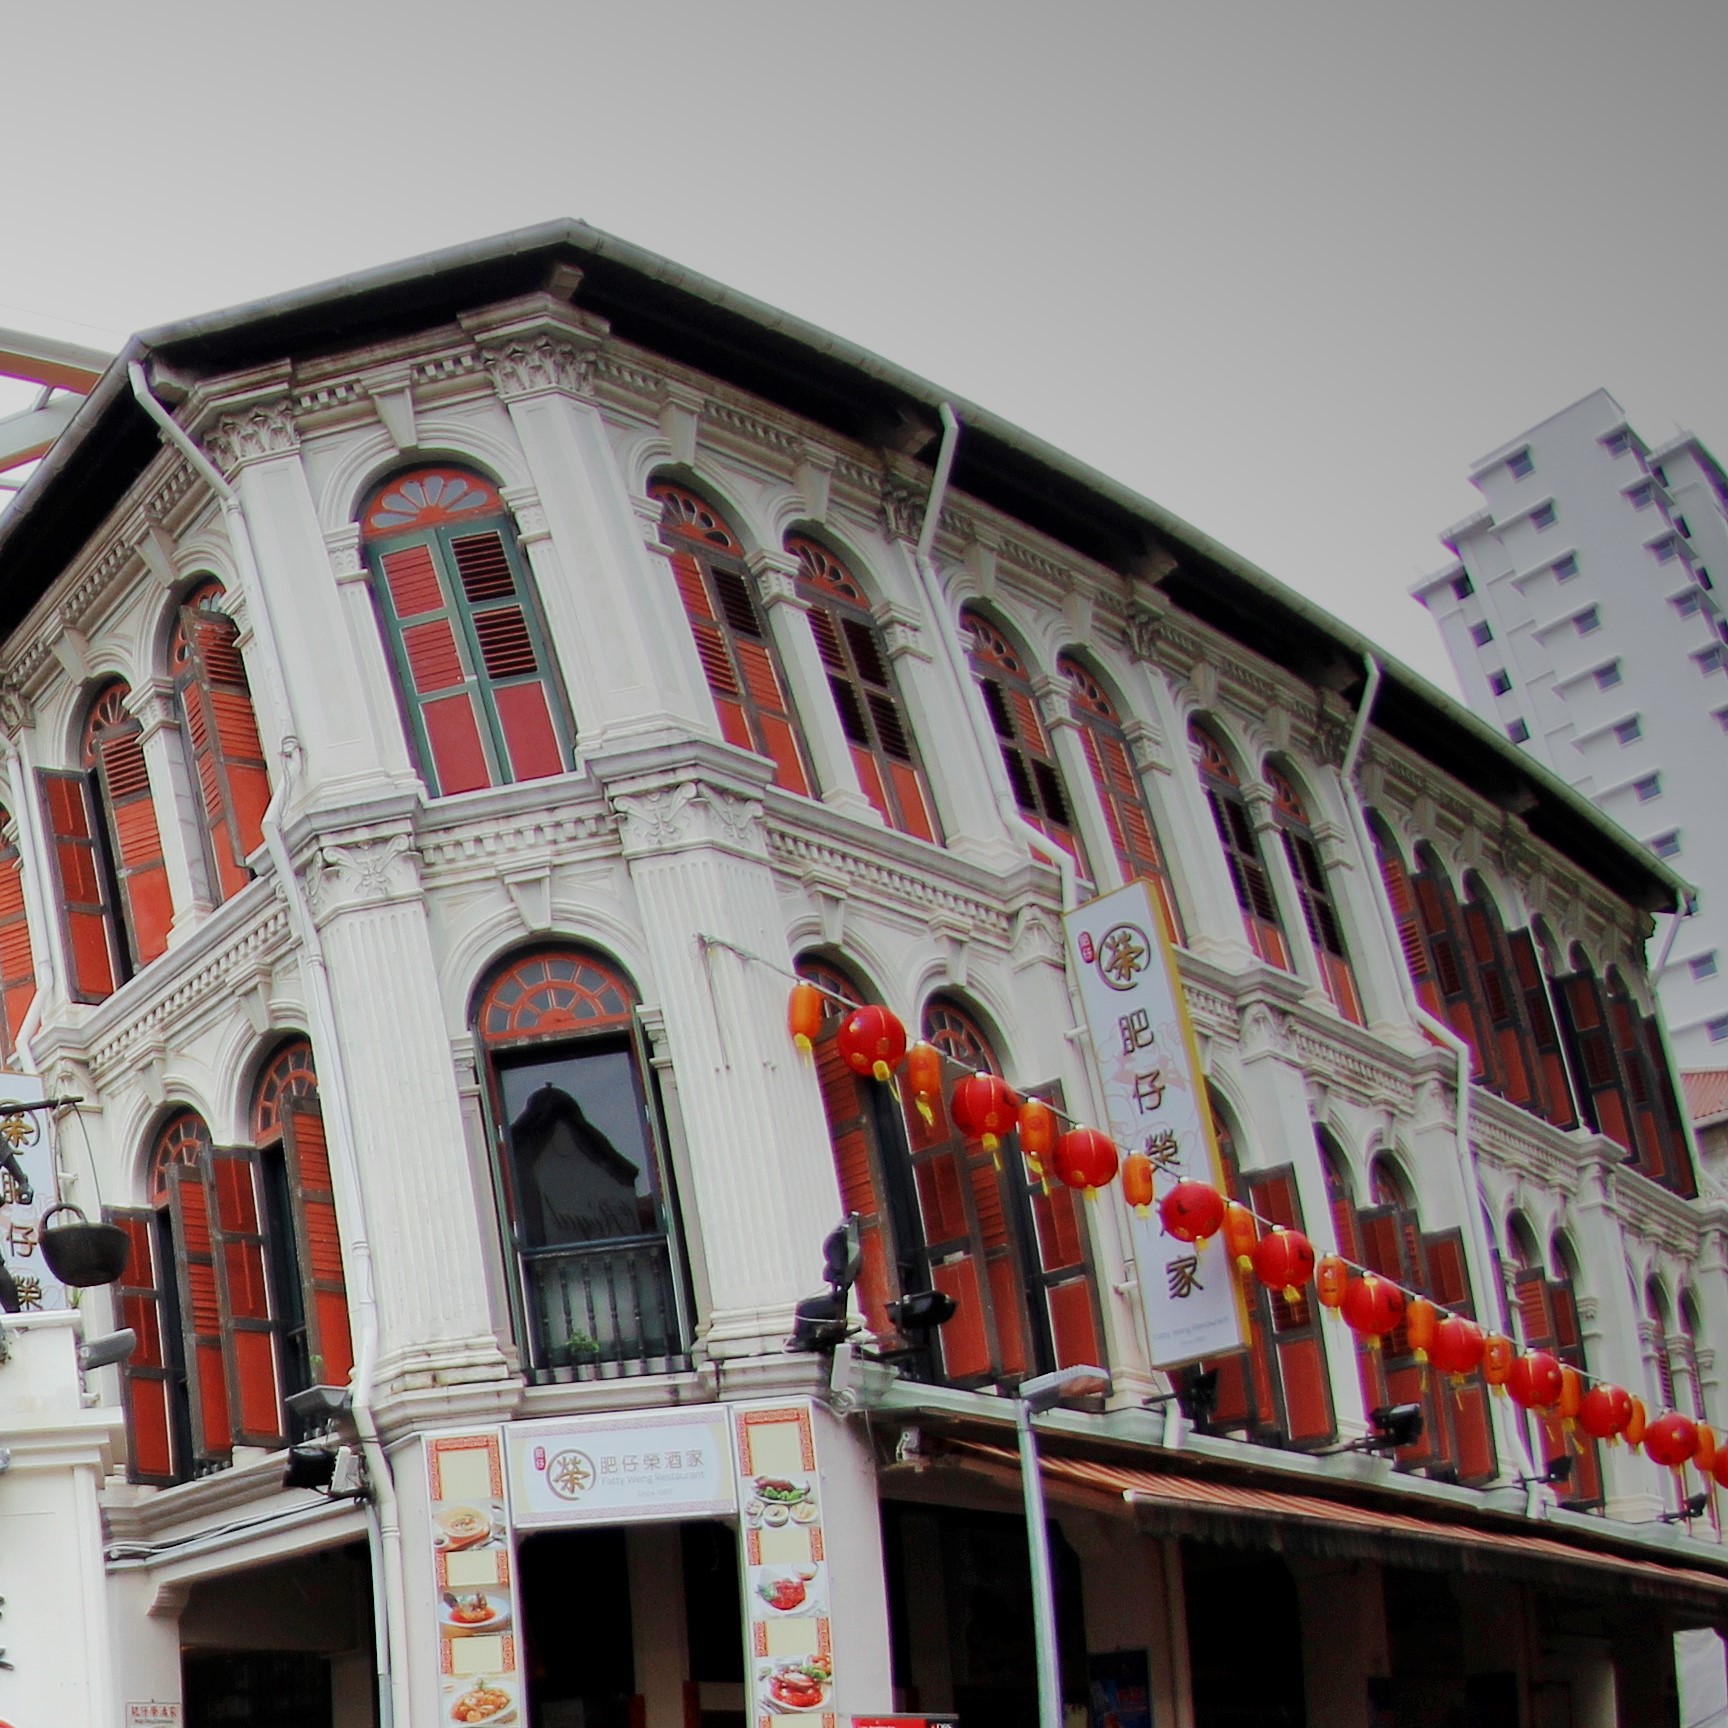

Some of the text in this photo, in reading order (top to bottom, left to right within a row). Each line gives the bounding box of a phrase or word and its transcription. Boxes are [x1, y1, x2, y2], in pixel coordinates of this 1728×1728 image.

[1117, 1007, 1204, 1300] 肥仔榮家
[601, 1475, 626, 1486] Fatty
[655, 1470, 705, 1482] Restaurant
